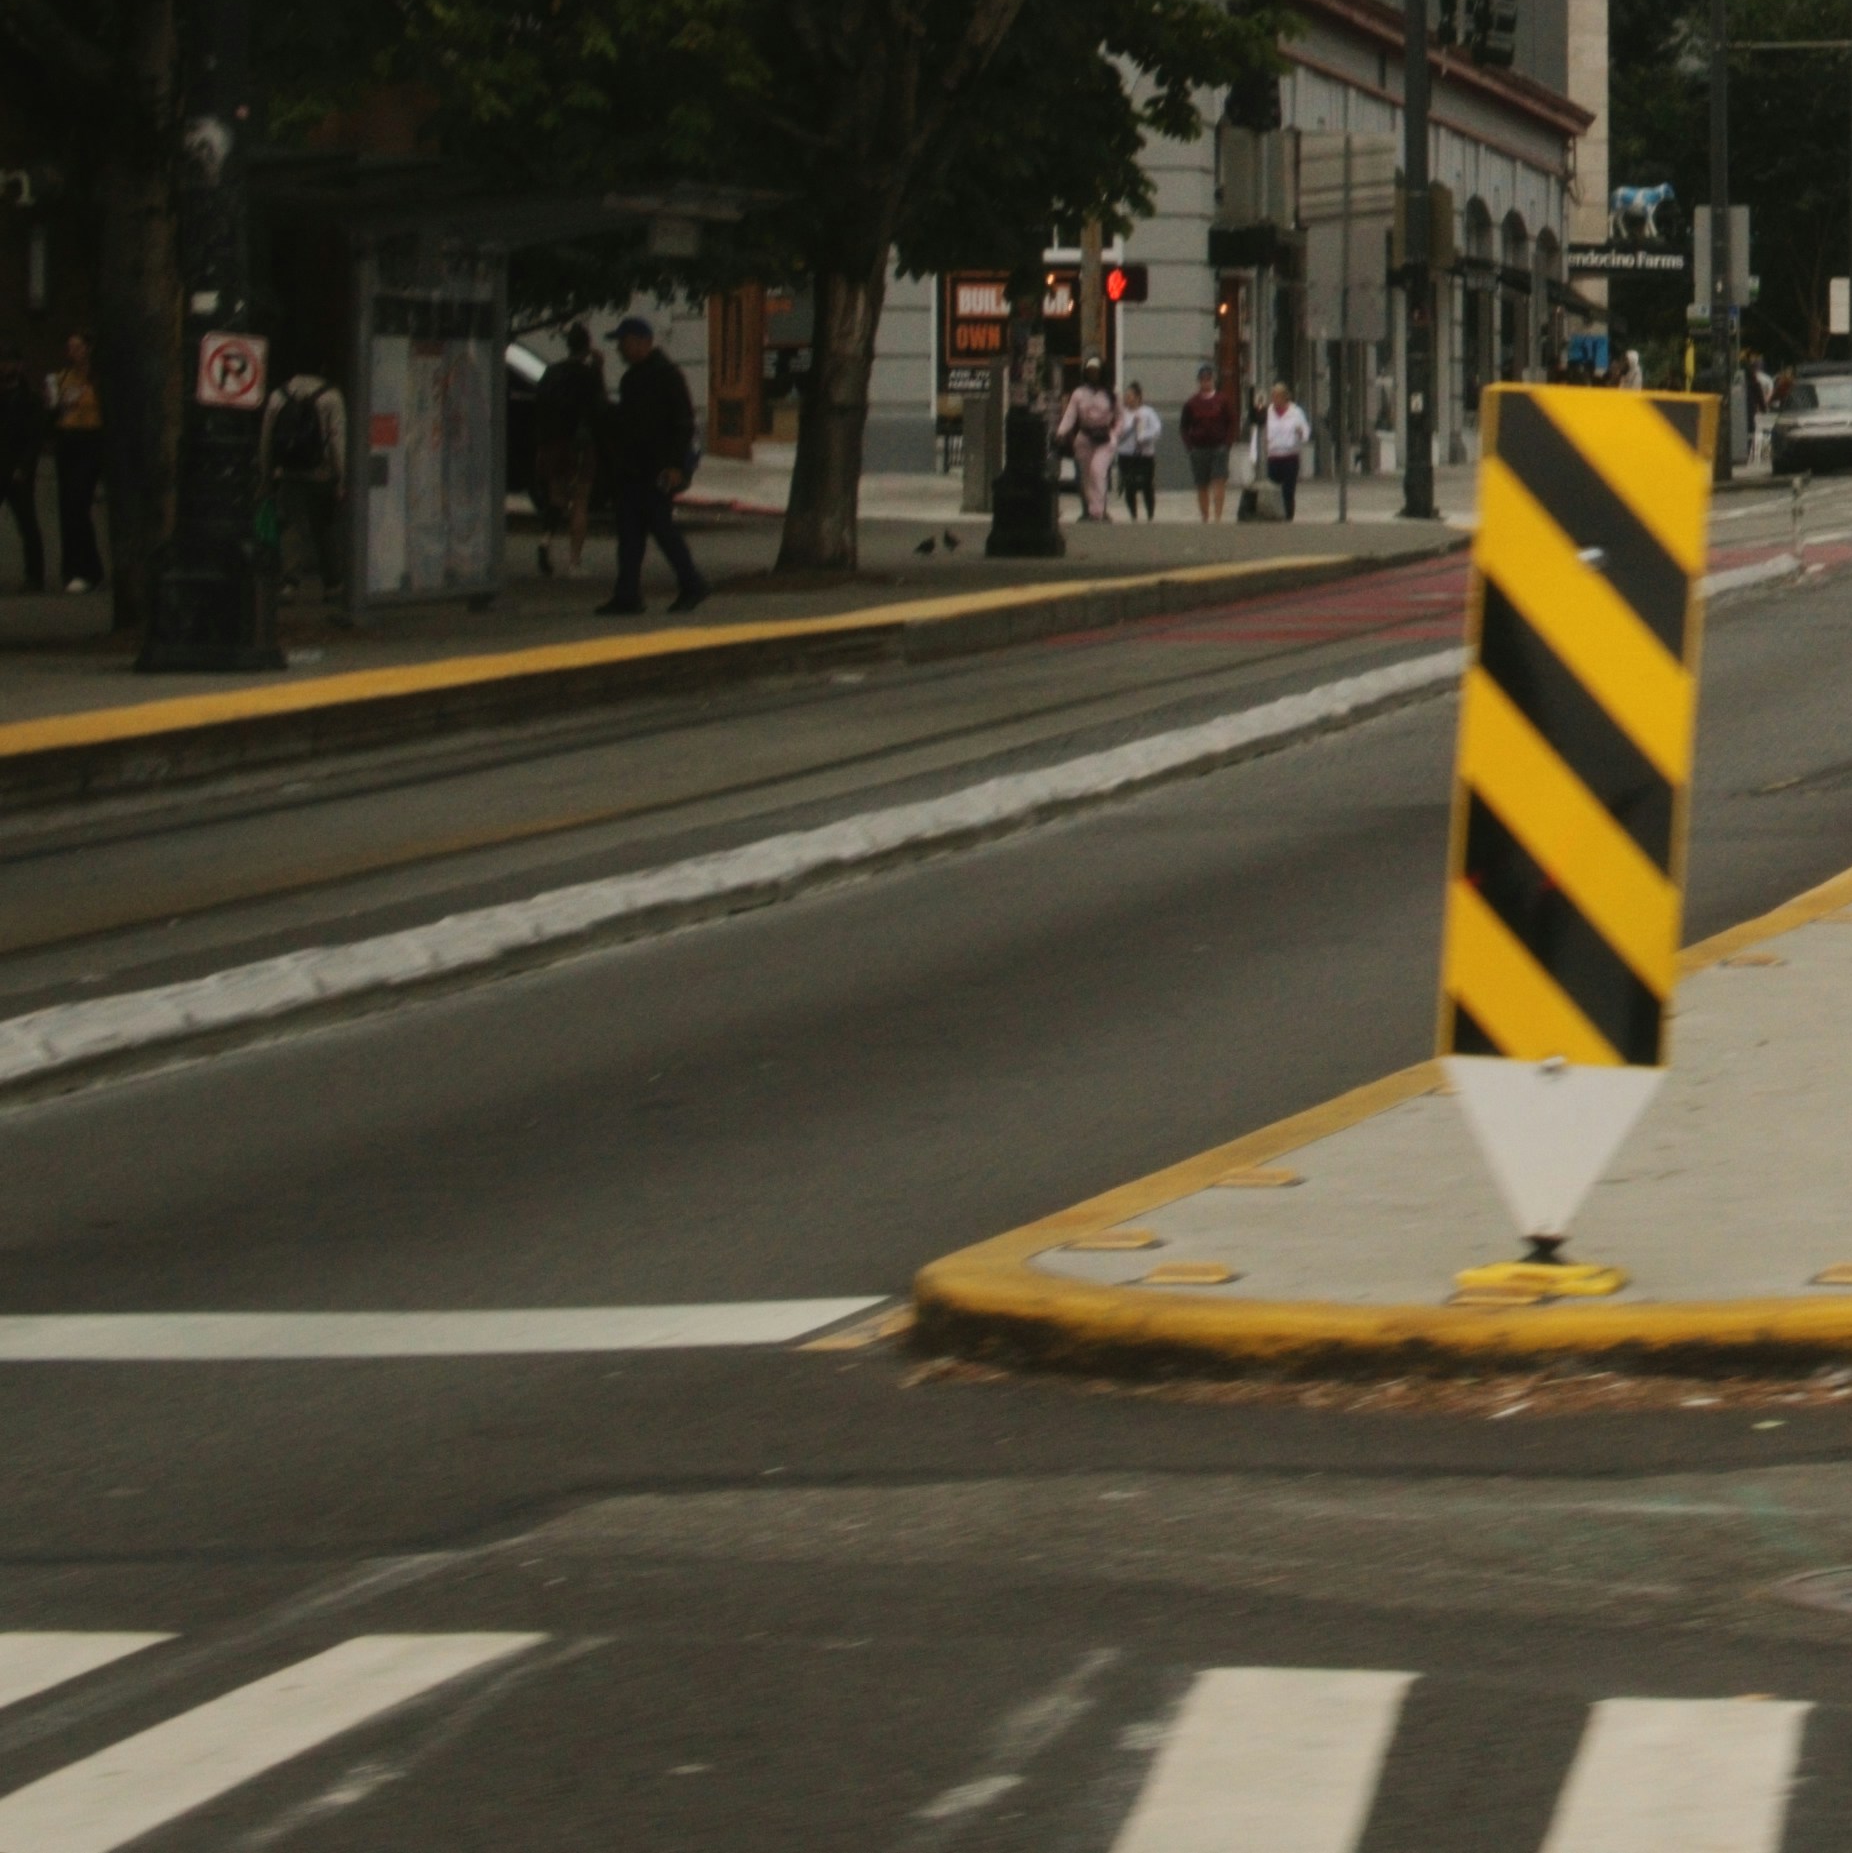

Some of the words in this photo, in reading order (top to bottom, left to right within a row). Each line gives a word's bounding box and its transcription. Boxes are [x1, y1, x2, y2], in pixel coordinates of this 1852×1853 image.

[1567, 249, 1635, 270] endocino
[1636, 250, 1685, 270] Farms
[956, 323, 1001, 351] OWN
